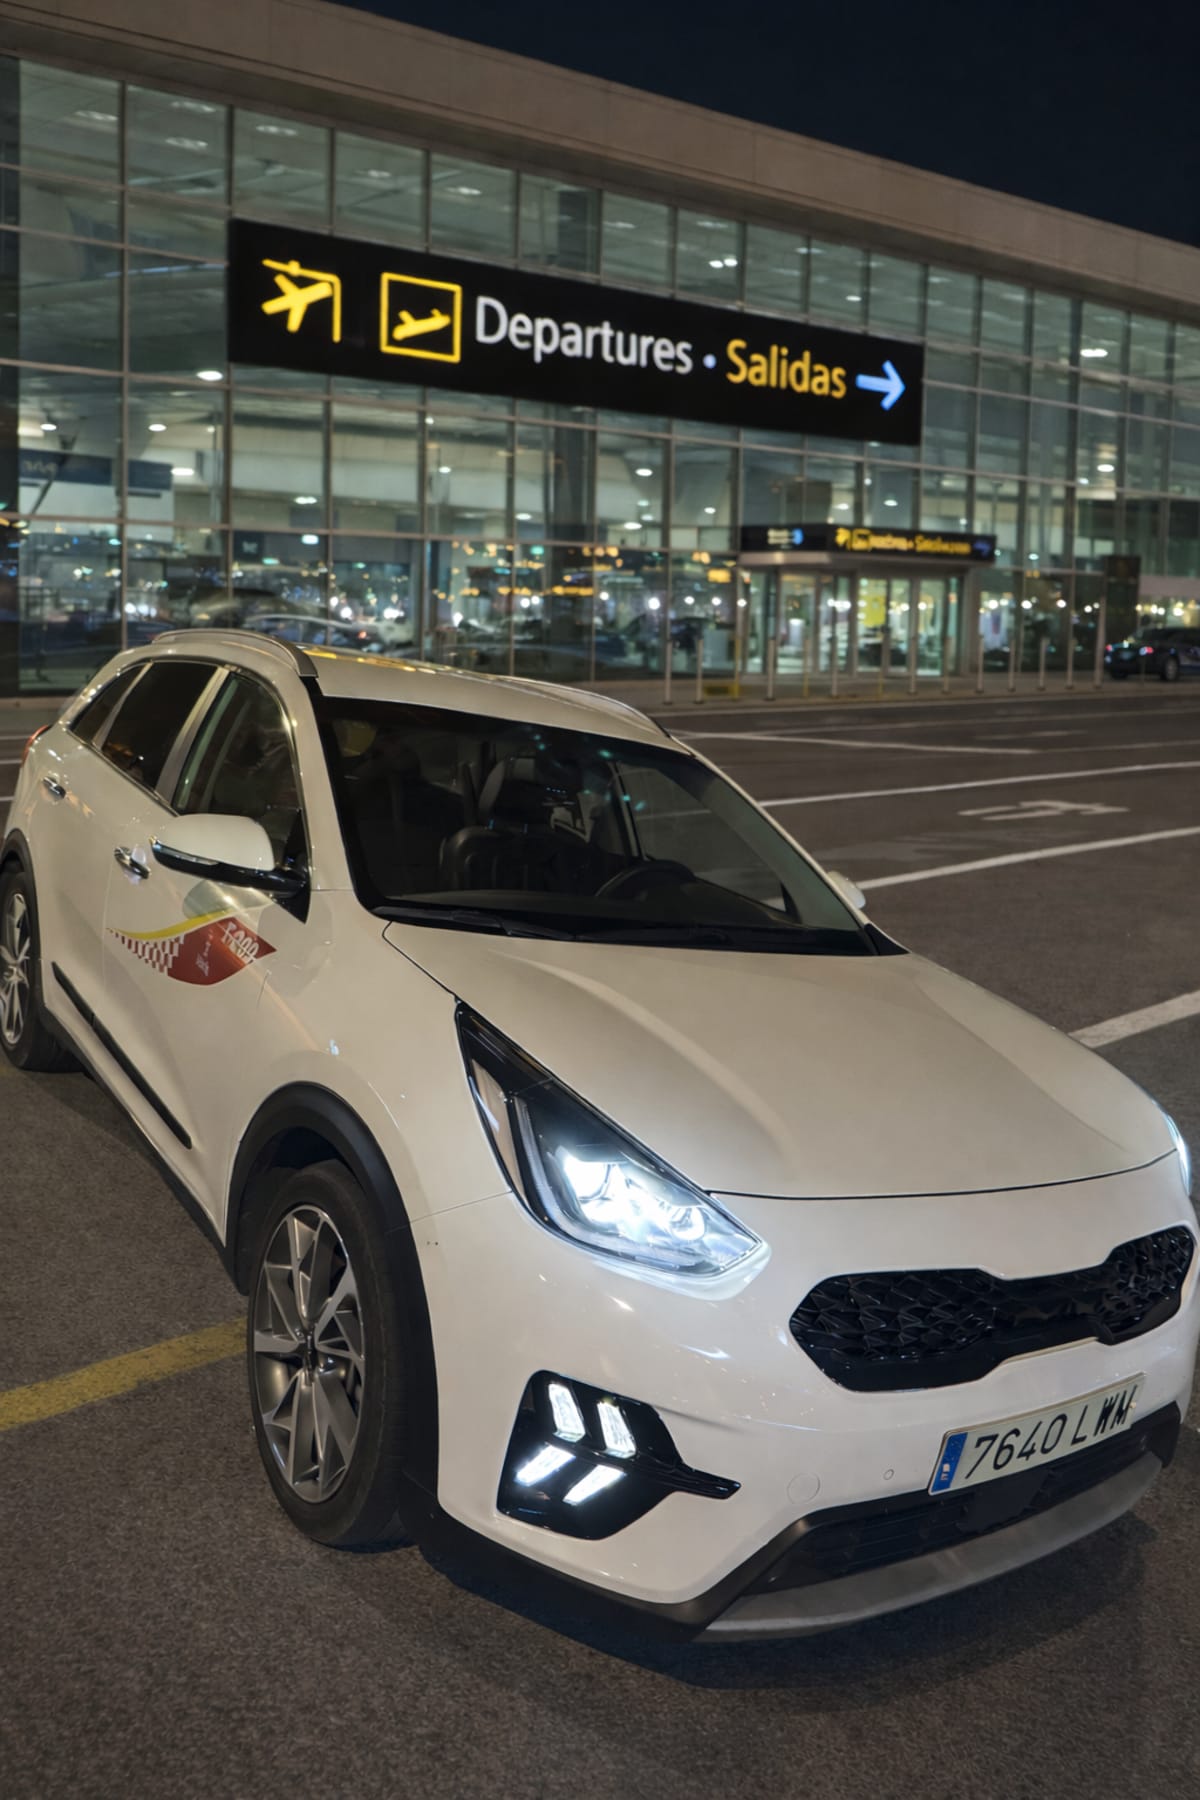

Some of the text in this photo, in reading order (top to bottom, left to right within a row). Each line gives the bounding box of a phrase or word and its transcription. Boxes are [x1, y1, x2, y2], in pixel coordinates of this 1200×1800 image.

[476, 296, 847, 398] Departures Salidas
[965, 1412, 1068, 1480] 7640
